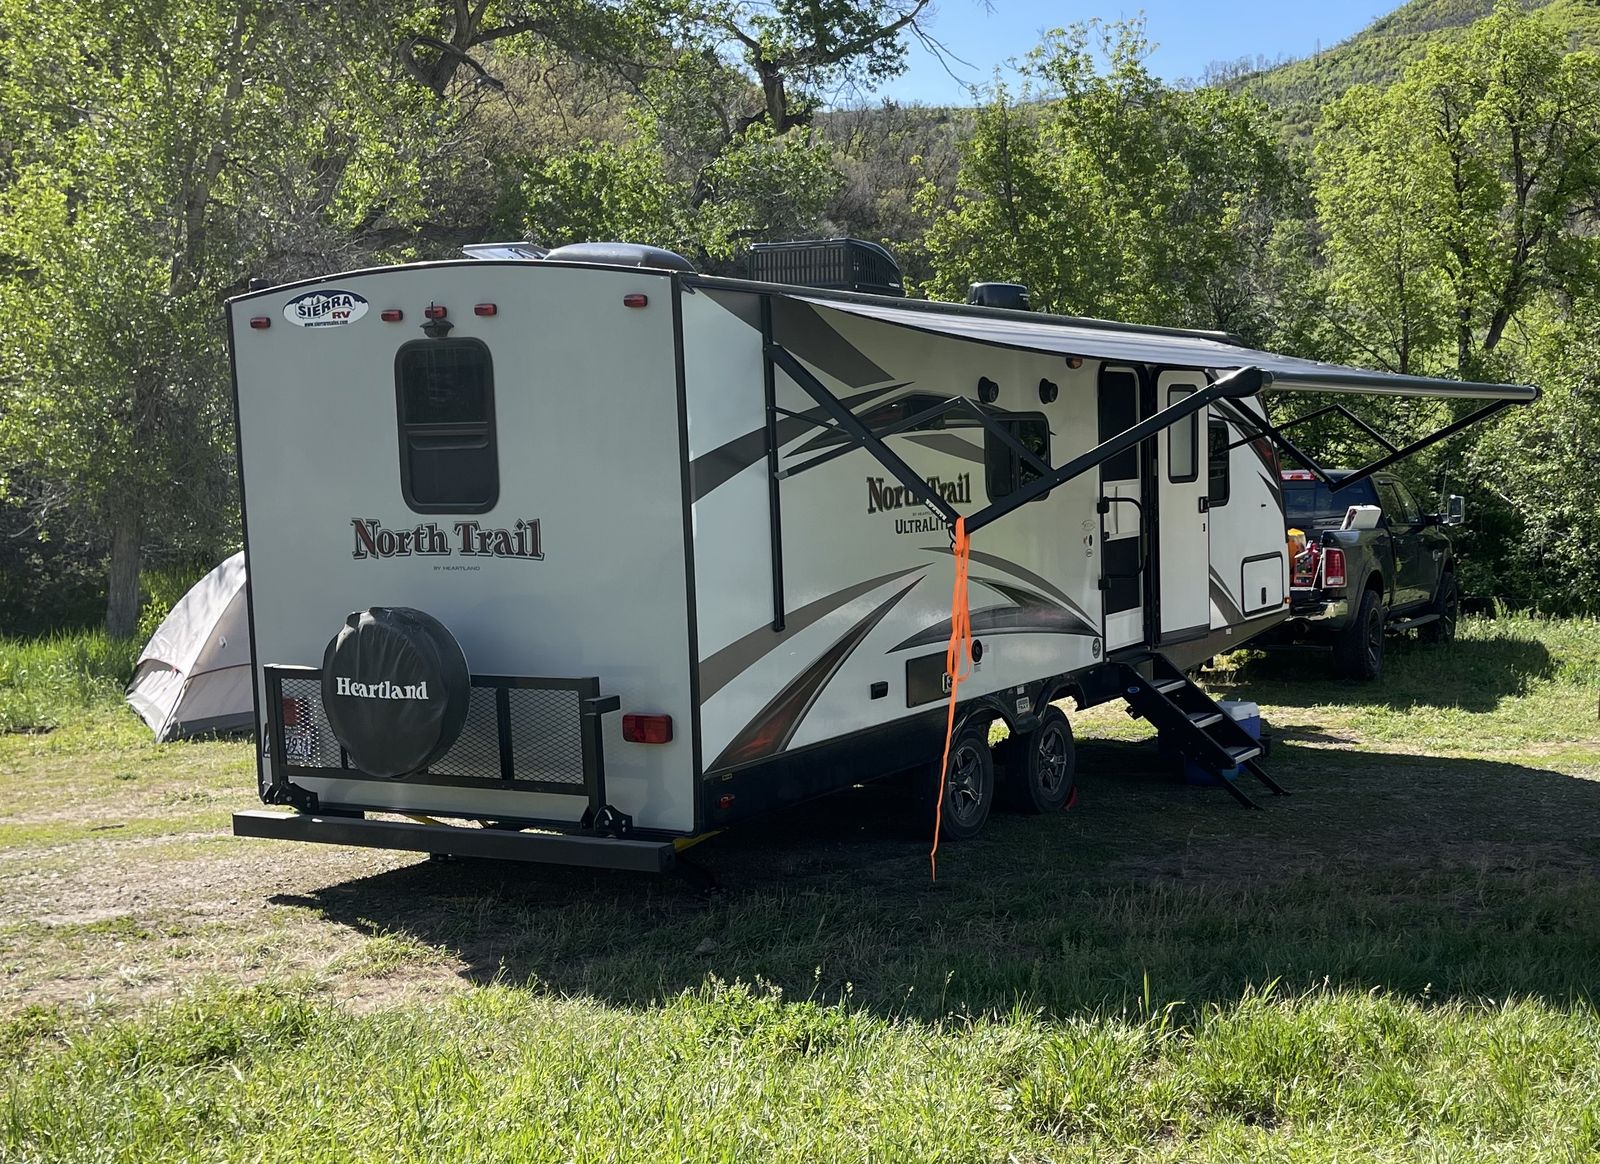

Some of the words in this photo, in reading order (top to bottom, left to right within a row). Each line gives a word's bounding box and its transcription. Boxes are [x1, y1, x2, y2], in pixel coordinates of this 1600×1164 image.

[298, 296, 353, 317] SIERRA
[332, 311, 351, 319] RV
[866, 476, 925, 515] Nort
[350, 518, 451, 560] North
[453, 518, 545, 561] Trail
[336, 677, 429, 700] Heartland
